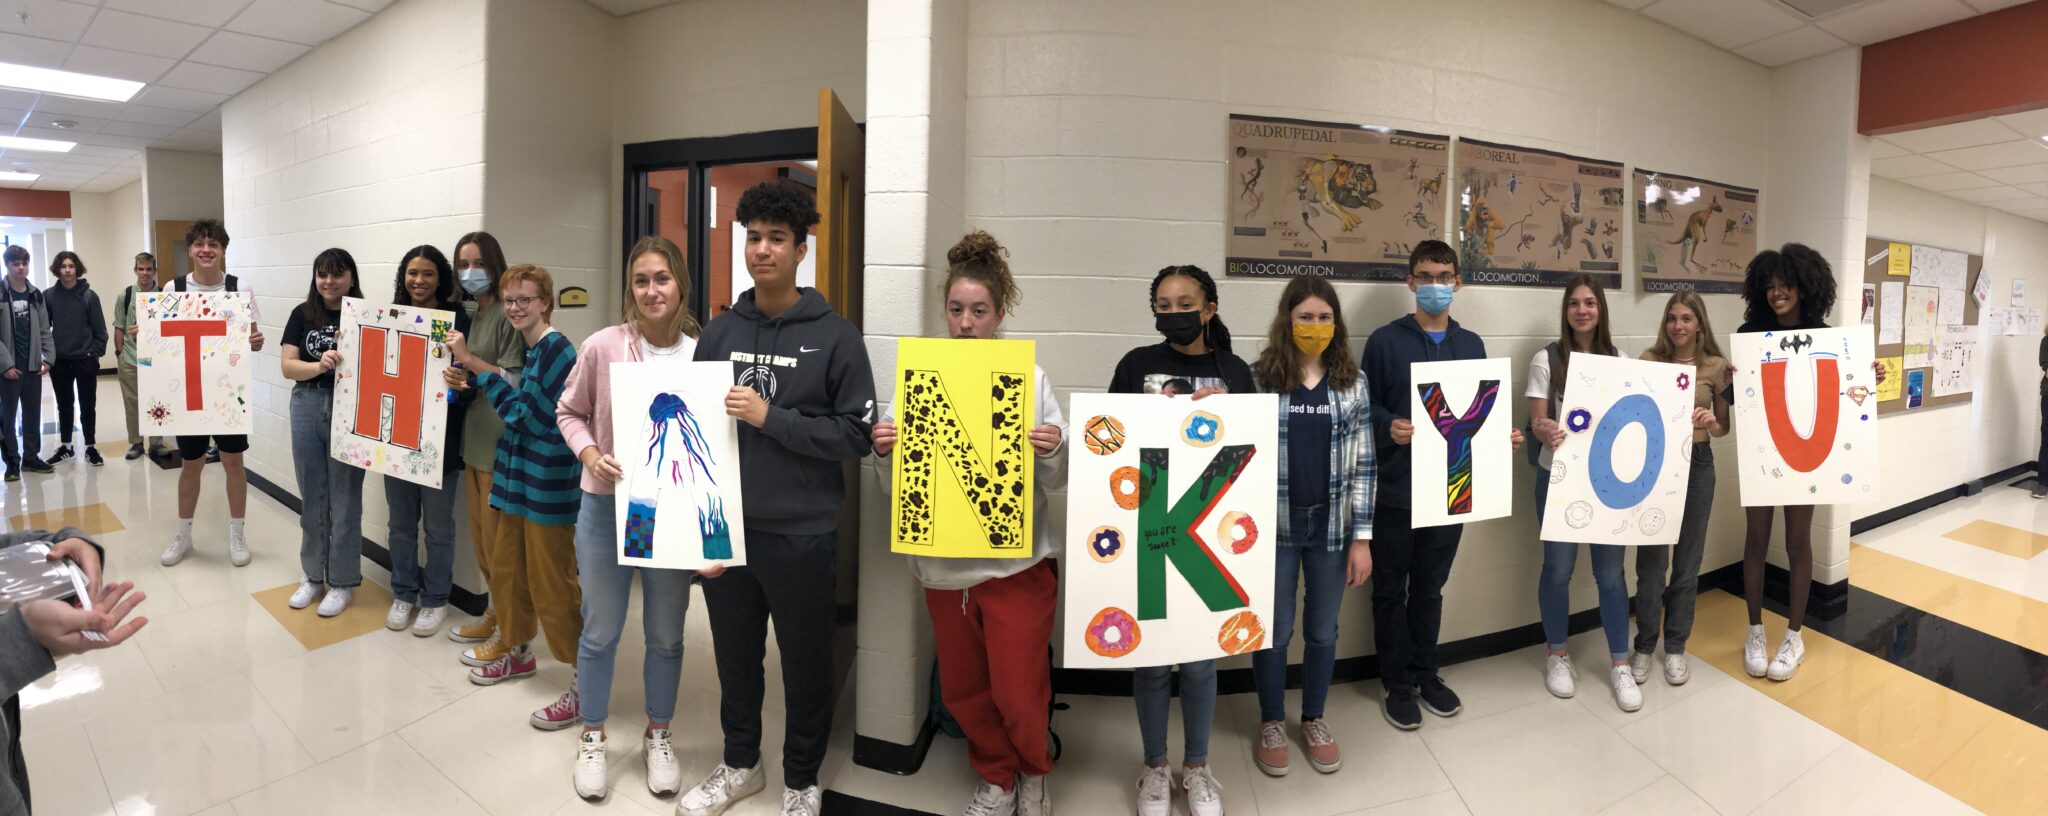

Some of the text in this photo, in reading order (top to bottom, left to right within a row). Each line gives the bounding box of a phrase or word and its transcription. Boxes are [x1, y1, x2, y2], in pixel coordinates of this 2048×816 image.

[1232, 123, 1337, 143] QUADRUPEDAL
[1229, 262, 1334, 277] BIOLOCOMOTION
[160, 320, 227, 411] T
[352, 324, 430, 452] H
[1289, 404, 1305, 414] sed
[1306, 404, 1315, 414] to
[1760, 358, 1840, 473] U
[898, 370, 1026, 548] N
[1417, 380, 1500, 515] Y
[1588, 393, 1666, 510] O
[1137, 443, 1257, 621] K
[1144, 525, 1176, 541] you are
